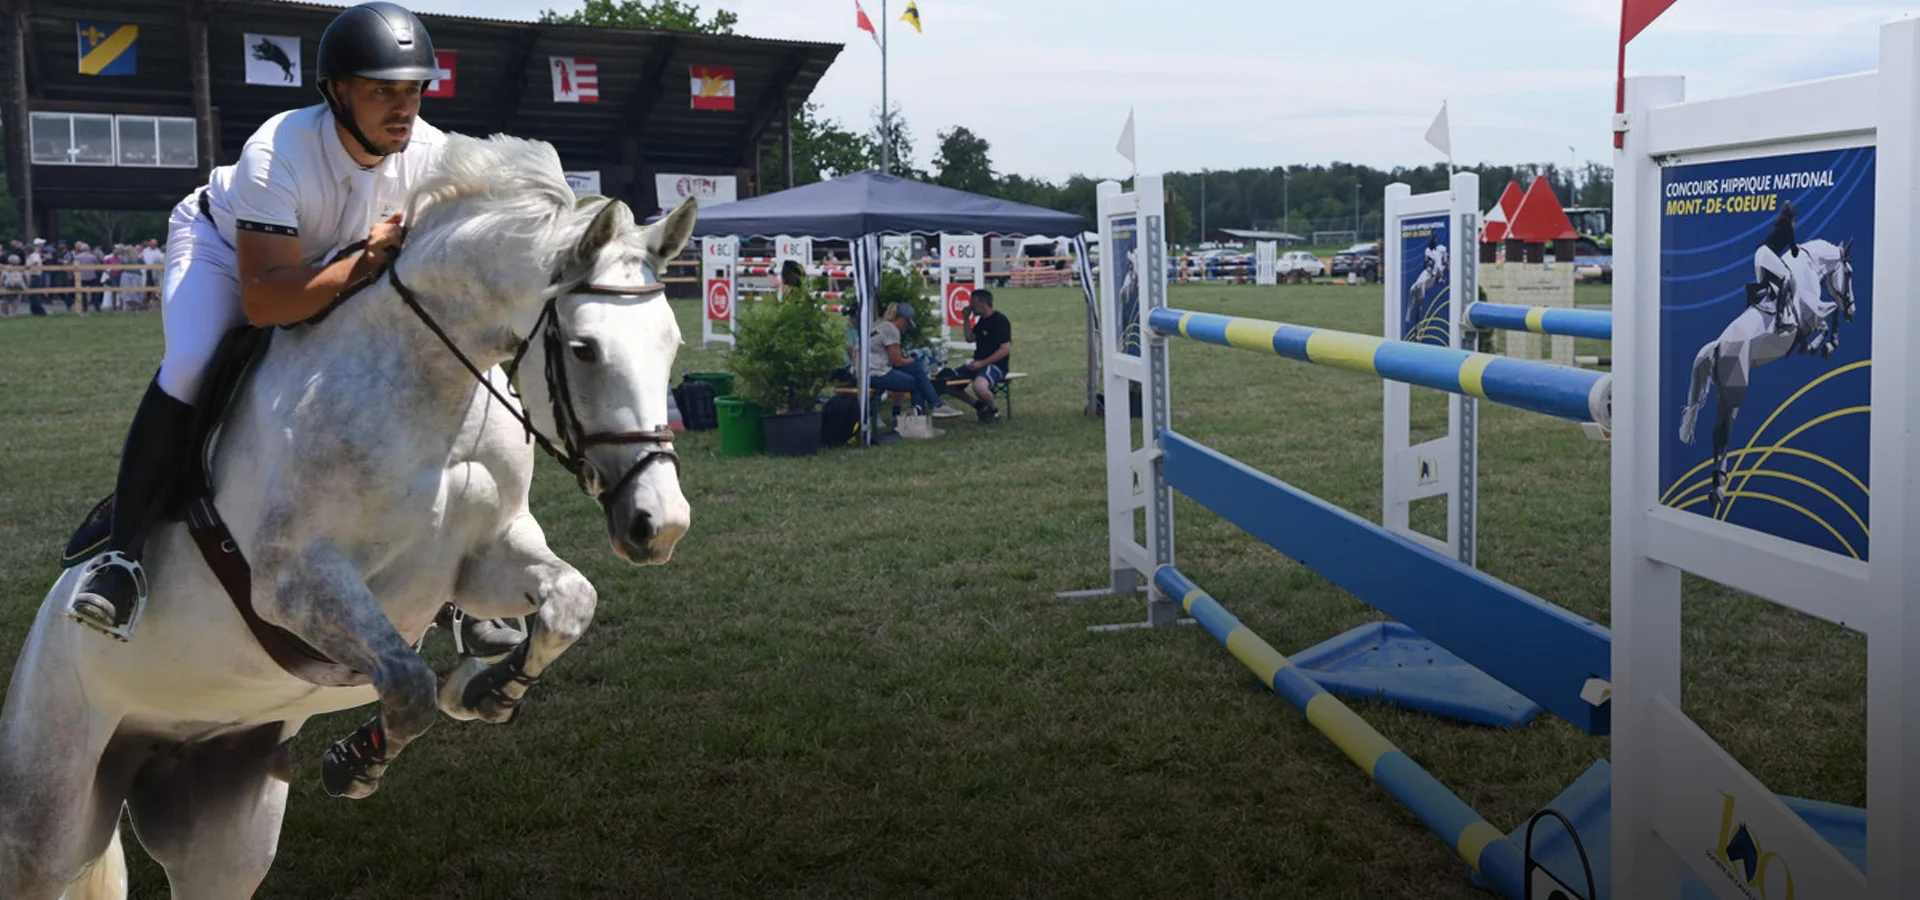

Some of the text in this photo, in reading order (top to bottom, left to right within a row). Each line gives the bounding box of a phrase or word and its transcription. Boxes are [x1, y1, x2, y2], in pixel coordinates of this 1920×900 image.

[1666, 170, 1834, 197] CONCOURS HIPPIQUE NATIONAL
[1666, 194, 1777, 216] MONT-DE-COEUVE
[958, 244, 975, 258] BCJ
